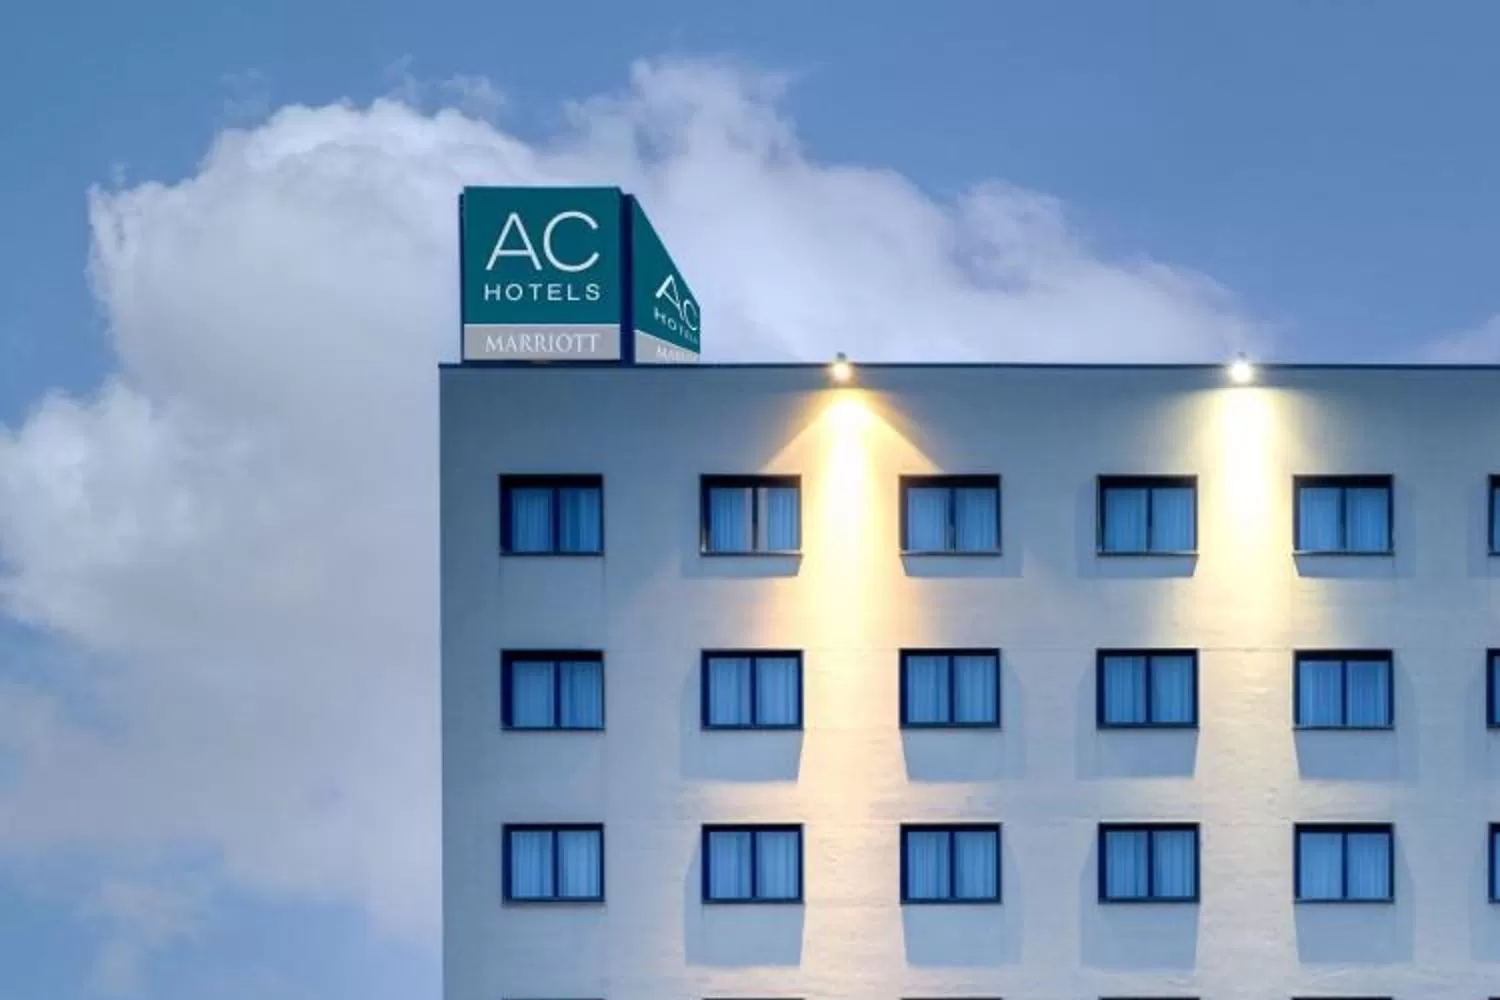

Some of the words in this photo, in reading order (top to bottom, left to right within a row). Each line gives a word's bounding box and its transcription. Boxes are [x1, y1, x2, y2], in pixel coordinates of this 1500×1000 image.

[485, 211, 599, 272] AC
[484, 283, 600, 301] HOTELS
[655, 274, 699, 331] AC
[485, 332, 600, 353] MARRIOTT
